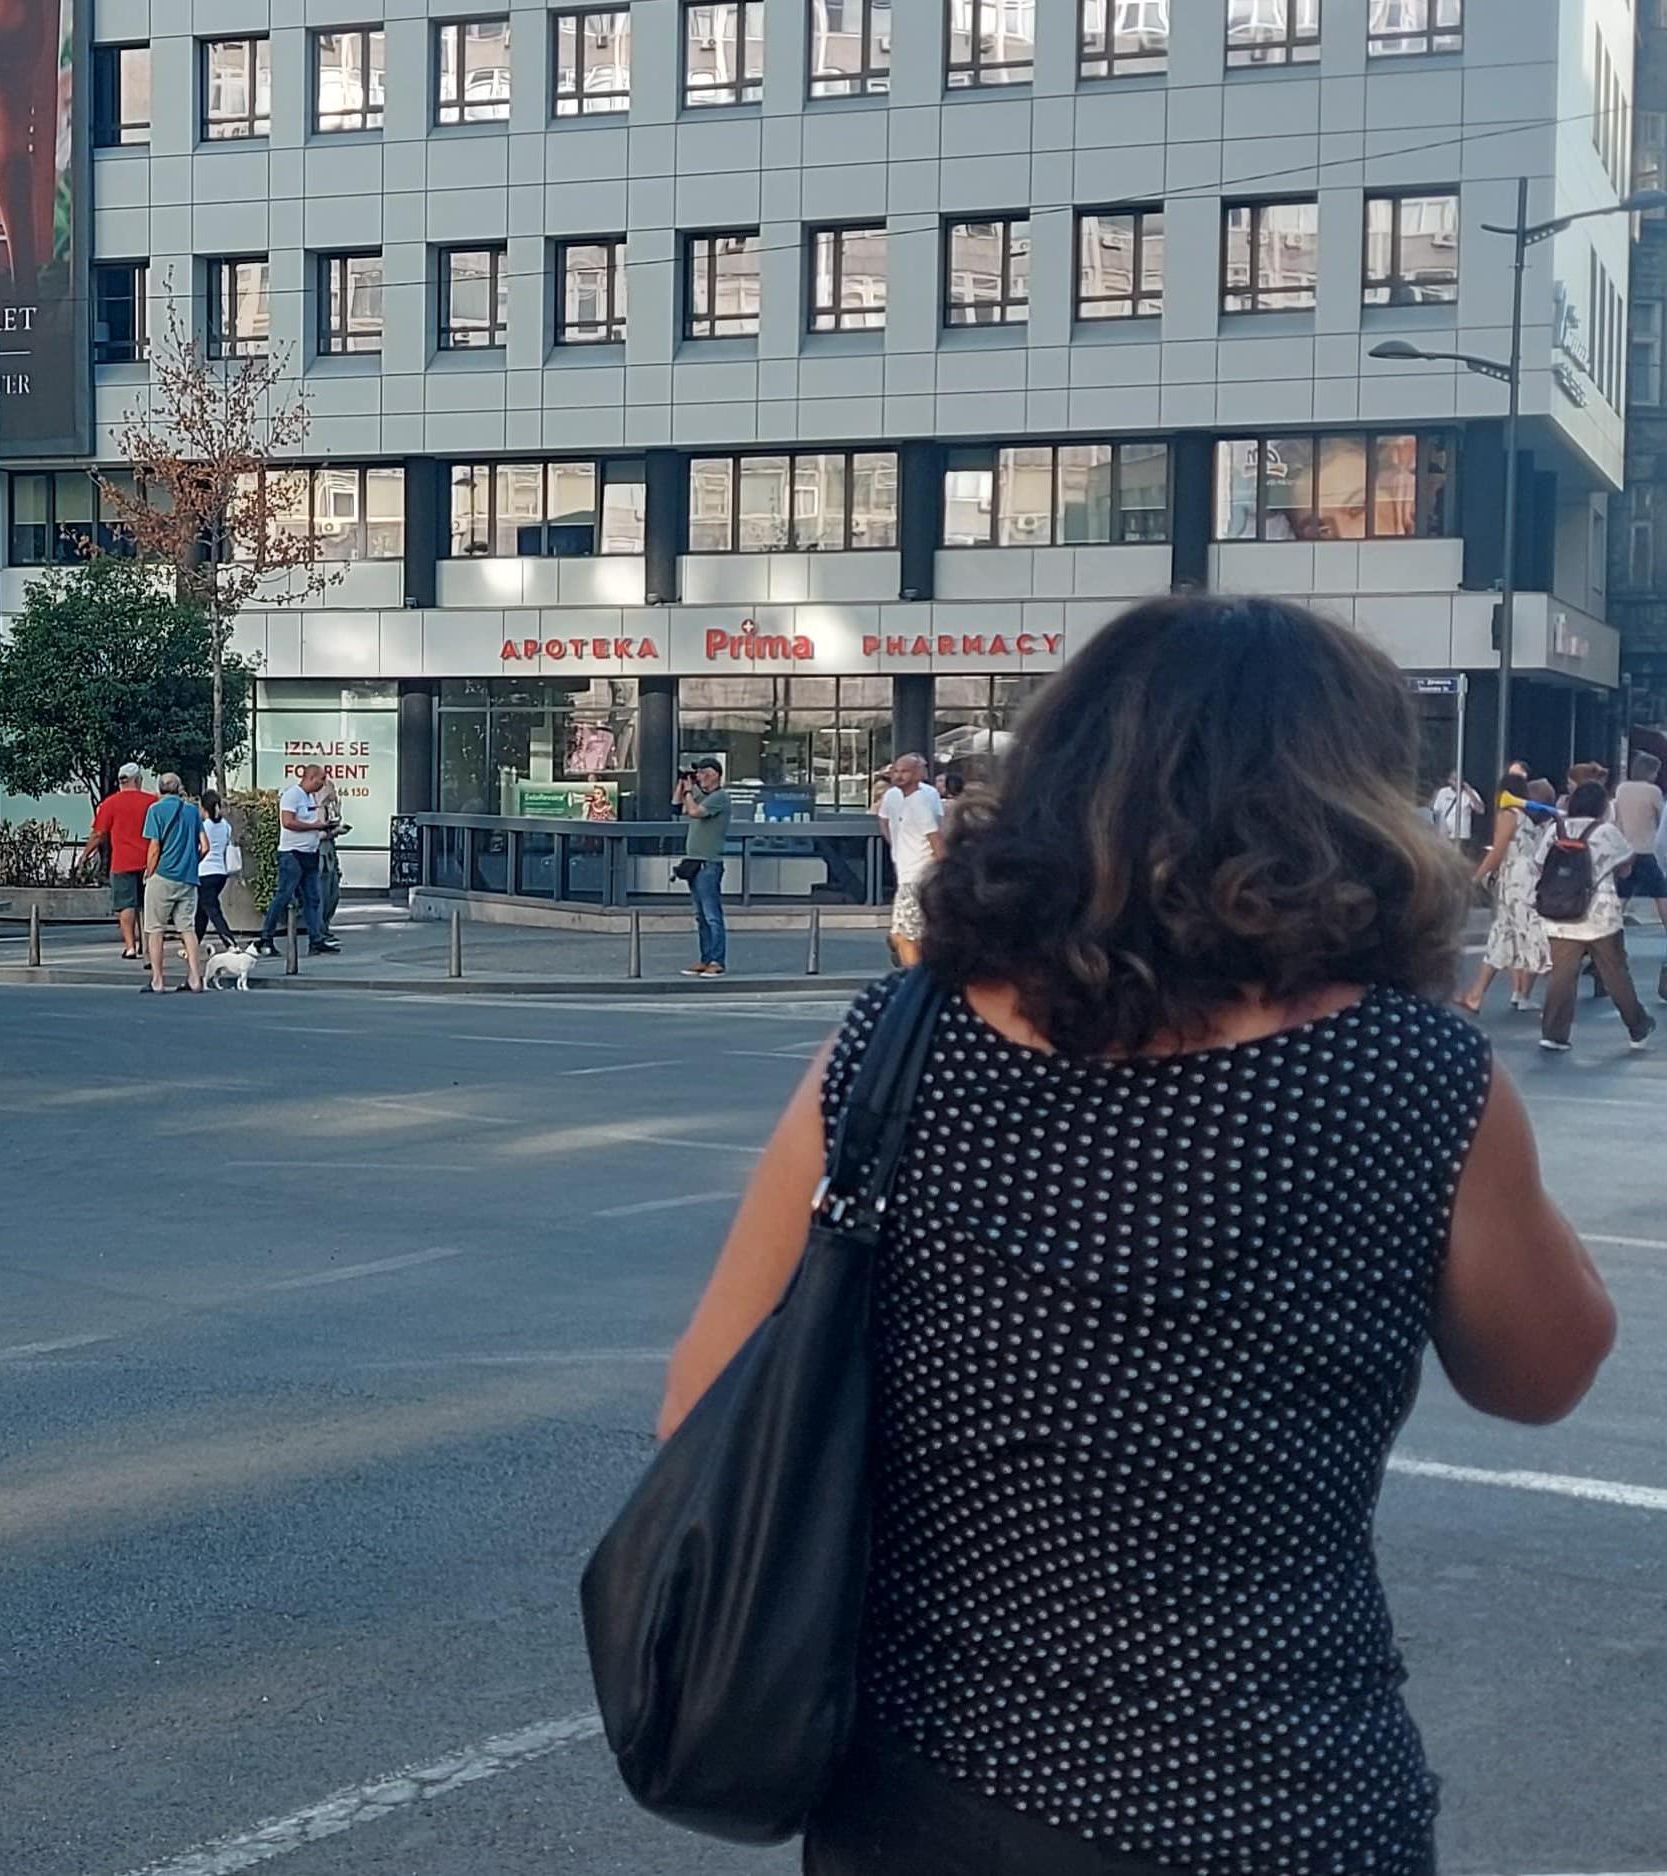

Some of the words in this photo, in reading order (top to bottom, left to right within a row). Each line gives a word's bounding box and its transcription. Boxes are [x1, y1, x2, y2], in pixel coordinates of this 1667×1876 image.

[500, 638, 658, 660] APOTEKA
[705, 619, 815, 661] Prima
[862, 633, 1061, 656] PHARMACY
[284, 741, 344, 756] IZDAJE
[349, 741, 370, 756] SE
[284, 765, 306, 778] FO
[325, 765, 370, 779] RENT
